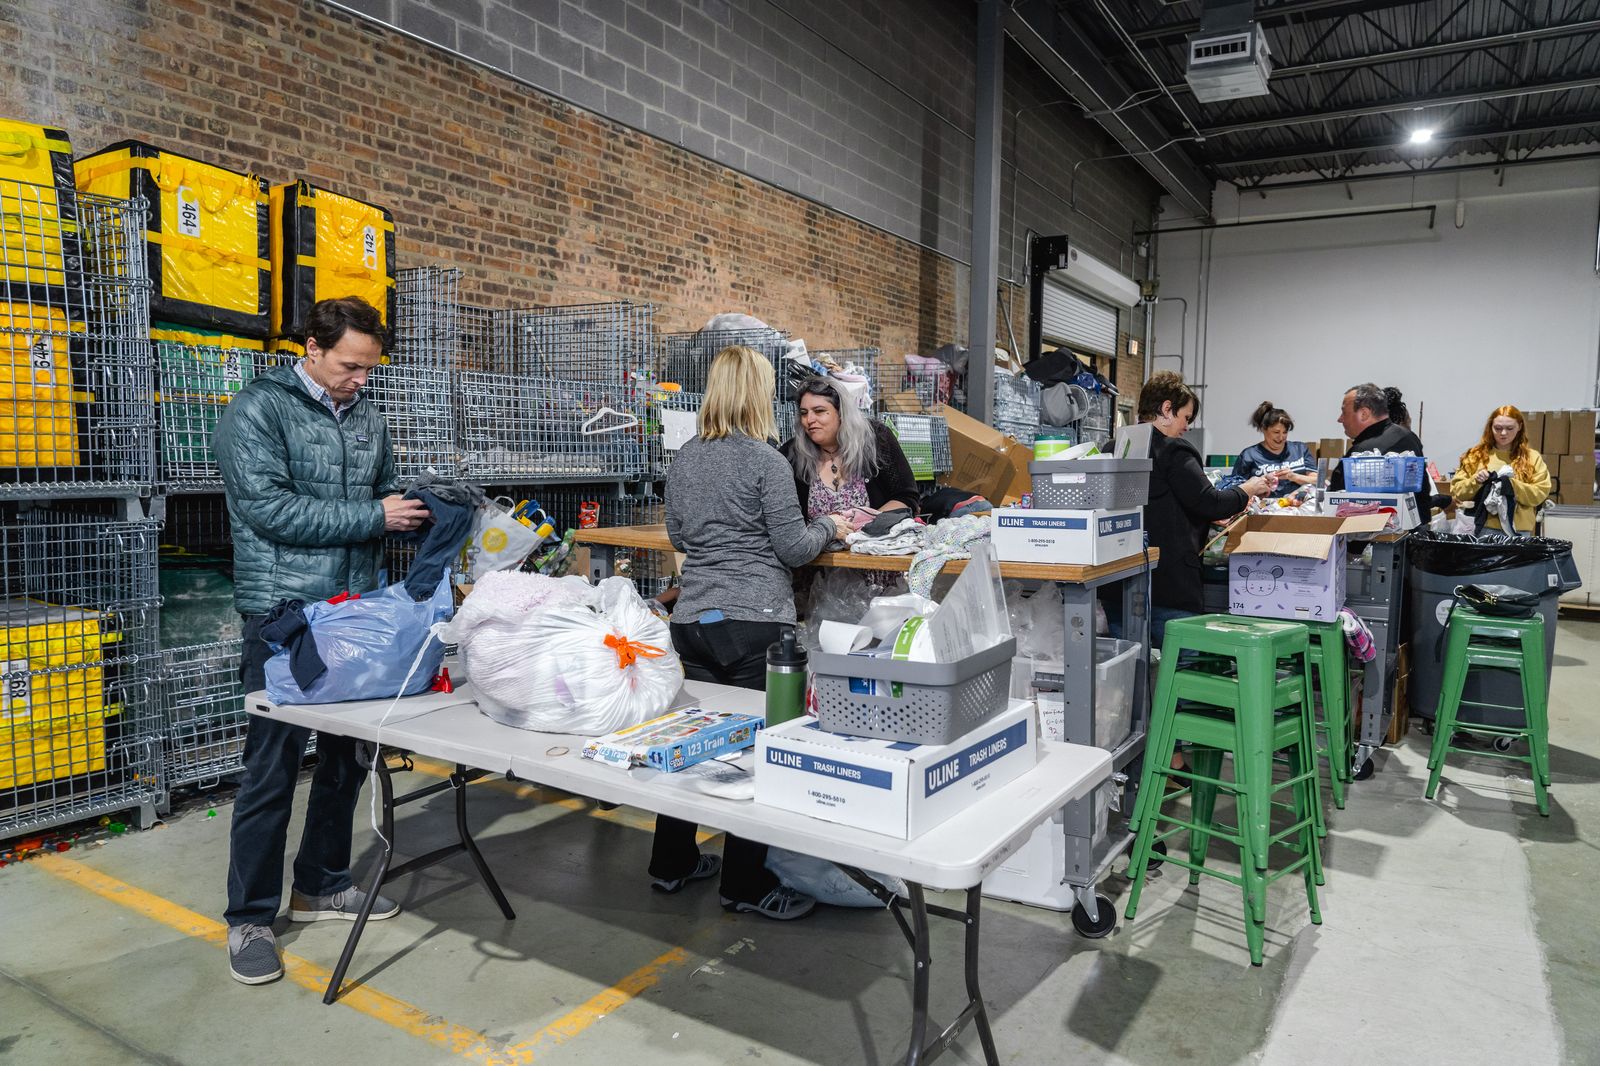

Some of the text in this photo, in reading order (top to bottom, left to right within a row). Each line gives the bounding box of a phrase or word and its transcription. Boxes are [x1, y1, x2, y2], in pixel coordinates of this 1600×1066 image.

[182, 203, 197, 228] 464
[365, 233, 375, 253] 142
[33, 342, 50, 368] 644
[1001, 518, 1024, 526] ULINE
[1314, 605, 1322, 616] 2
[687, 736, 725, 757] 123 Train
[770, 750, 861, 780] ULINE TRASH LINERS
[928, 758, 960, 791] ULINE
[969, 748, 988, 767] TRASH
[988, 738, 1008, 757] LINERS
